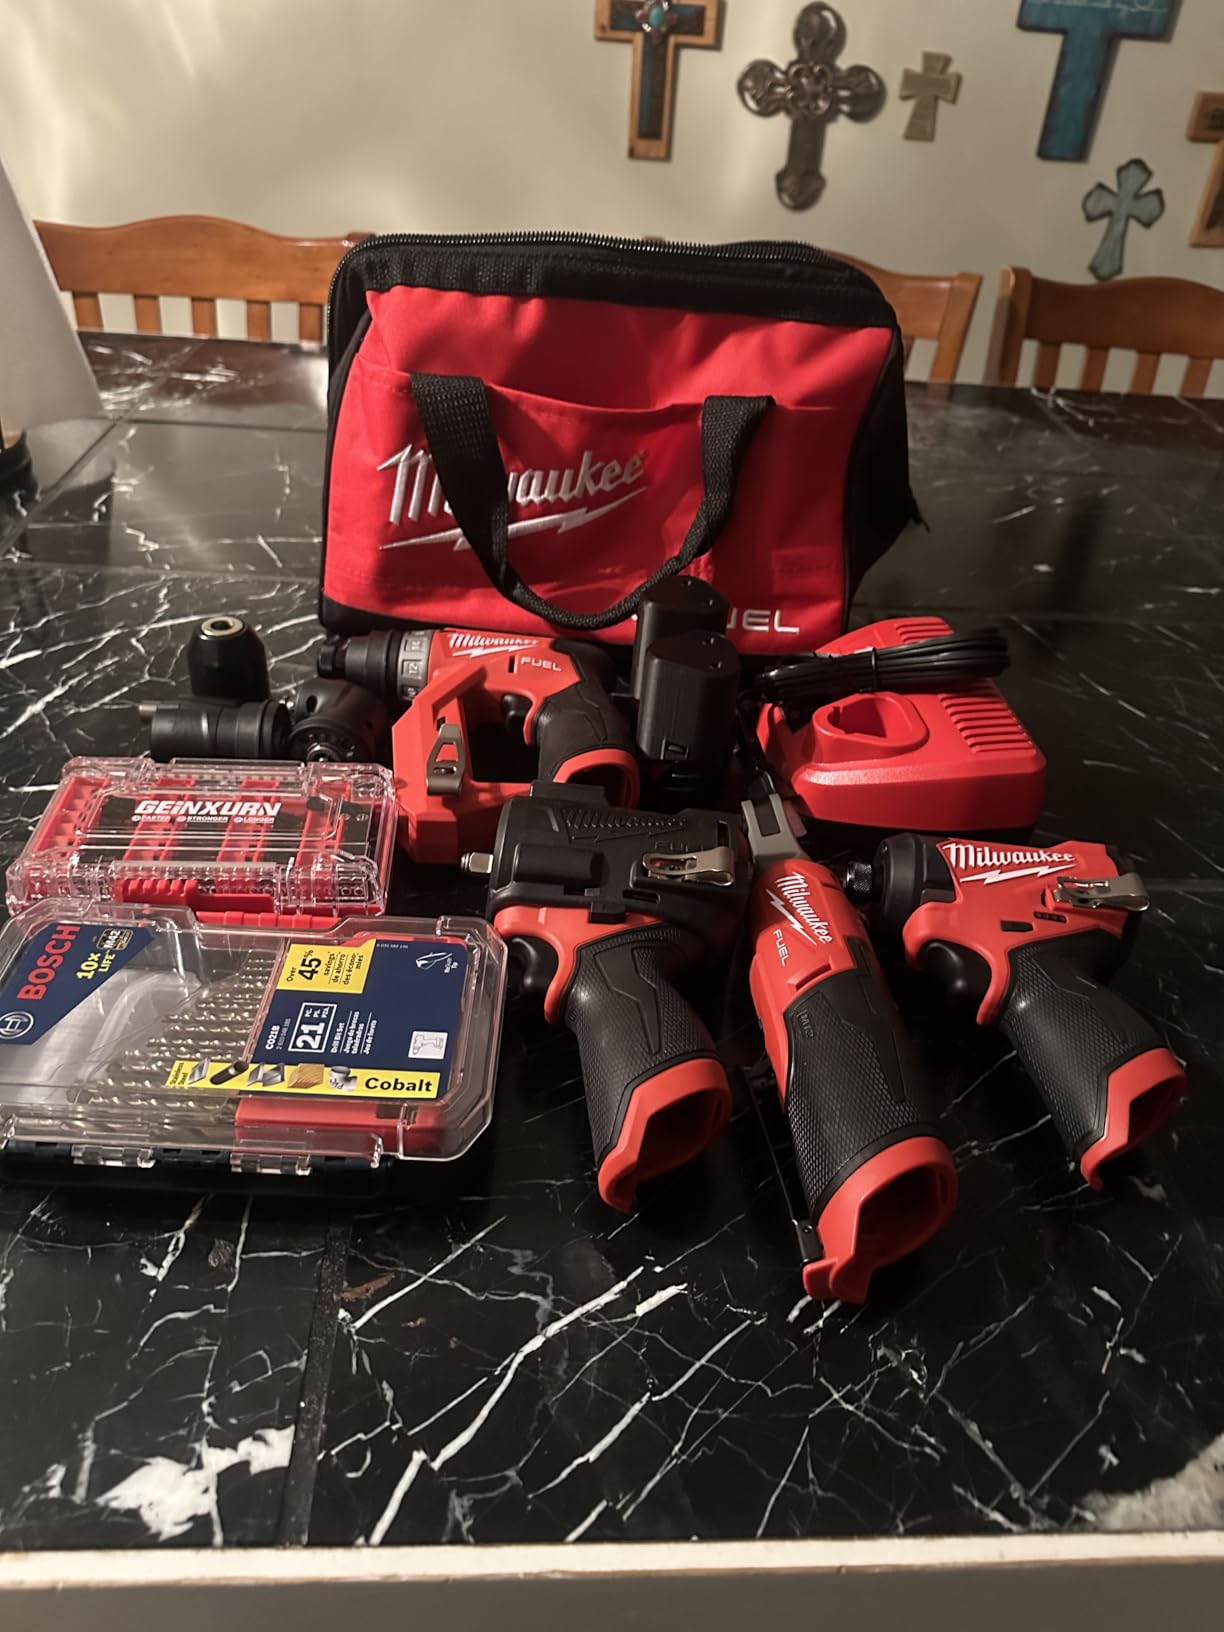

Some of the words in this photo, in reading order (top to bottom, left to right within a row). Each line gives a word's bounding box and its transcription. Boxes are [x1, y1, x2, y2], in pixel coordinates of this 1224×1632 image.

[377, 443, 646, 526] Maukee
[448, 633, 540, 649] Milwaukee
[408, 662, 418, 674] 12
[520, 656, 562, 672] FUEL
[186, 815, 228, 823] STRONGER
[942, 842, 1076, 870] Milwaukee
[776, 871, 833, 945] Milwaukee
[103, 930, 122, 949] M42
[772, 928, 790, 968] FUEL
[17, 925, 81, 1000] BOSCH
[76, 952, 101, 980] 10x
[286, 966, 297, 982] Over
[332, 974, 340, 983] de
[342, 973, 352, 985] des
[296, 1022, 326, 1049] 21
[336, 1022, 345, 1033] Set
[334, 1032, 342, 1041] Bit
[330, 1040, 340, 1053] Drill
[363, 1043, 372, 1055] Jeu
[364, 1076, 433, 1092] Cobalt
